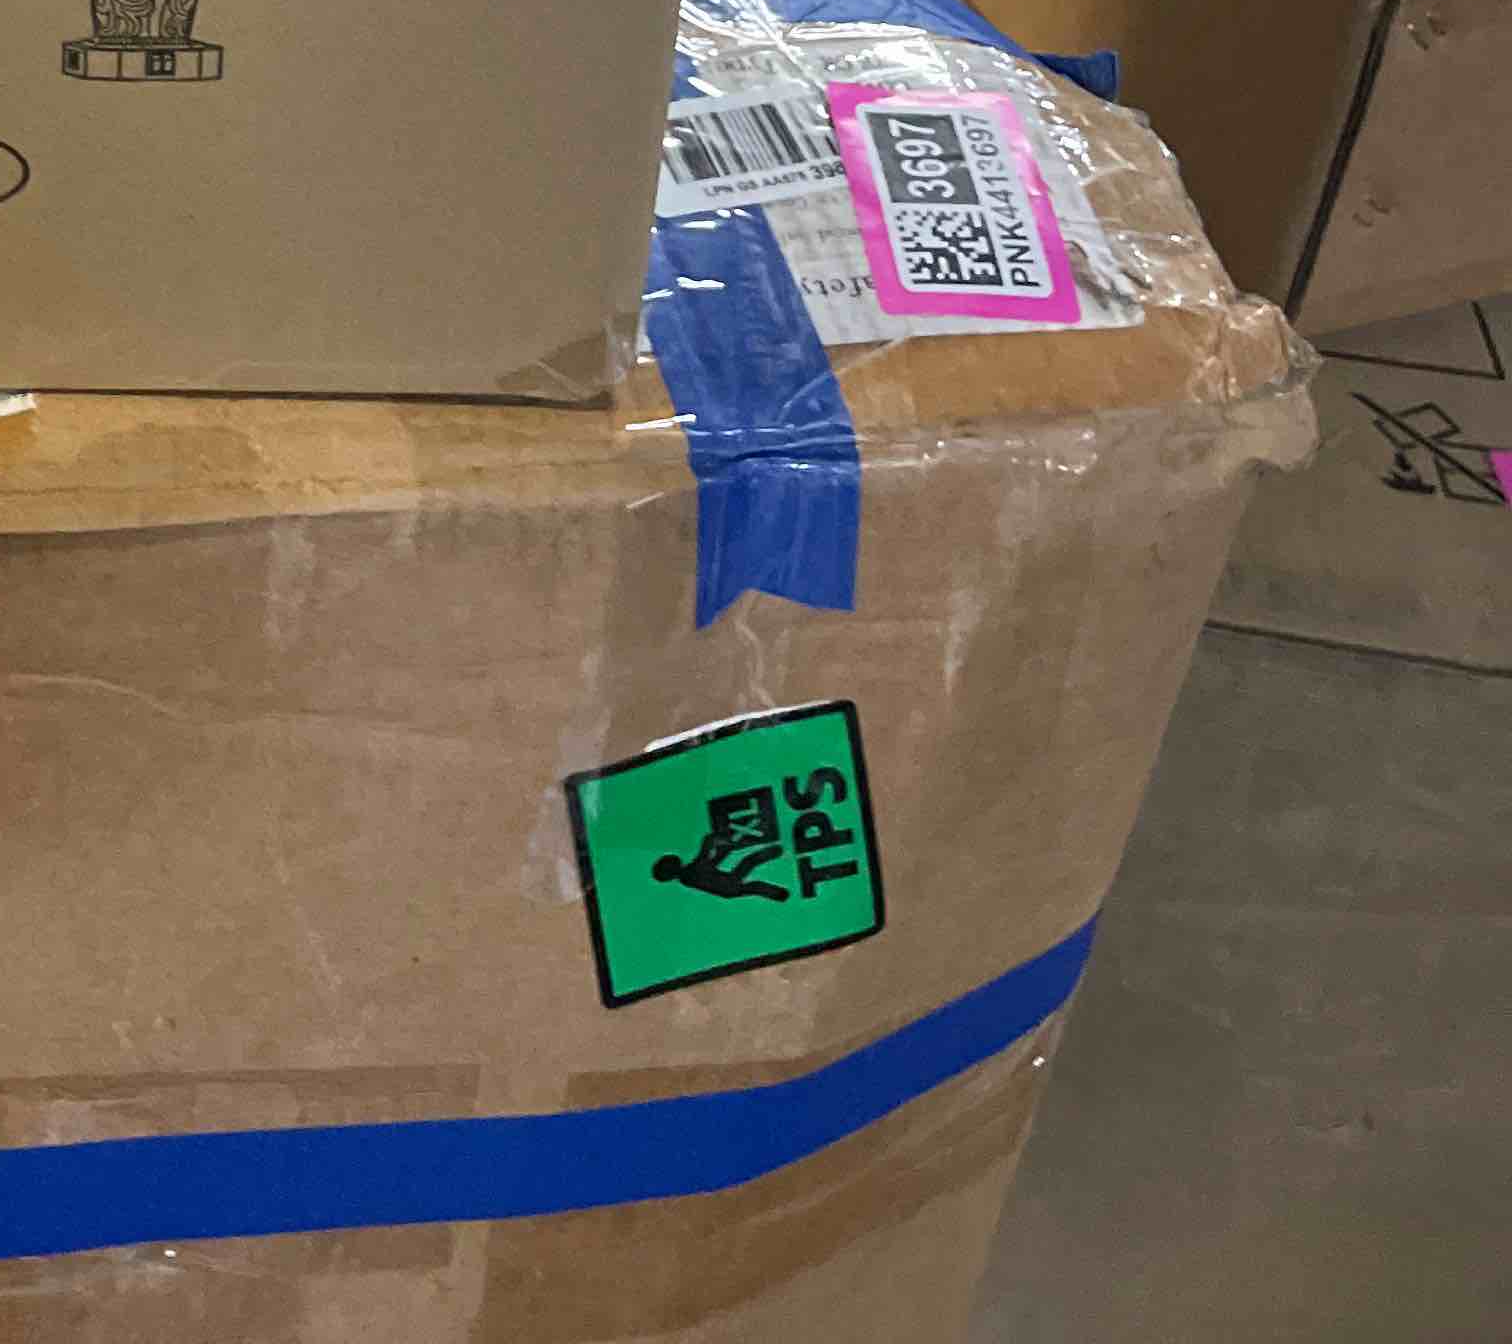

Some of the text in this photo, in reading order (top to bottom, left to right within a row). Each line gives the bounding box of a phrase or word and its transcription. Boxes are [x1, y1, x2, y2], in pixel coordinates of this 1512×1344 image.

[888, 117, 956, 199] 3697
[960, 113, 1042, 288] PNK4413697
[782, 765, 860, 900] TPS
